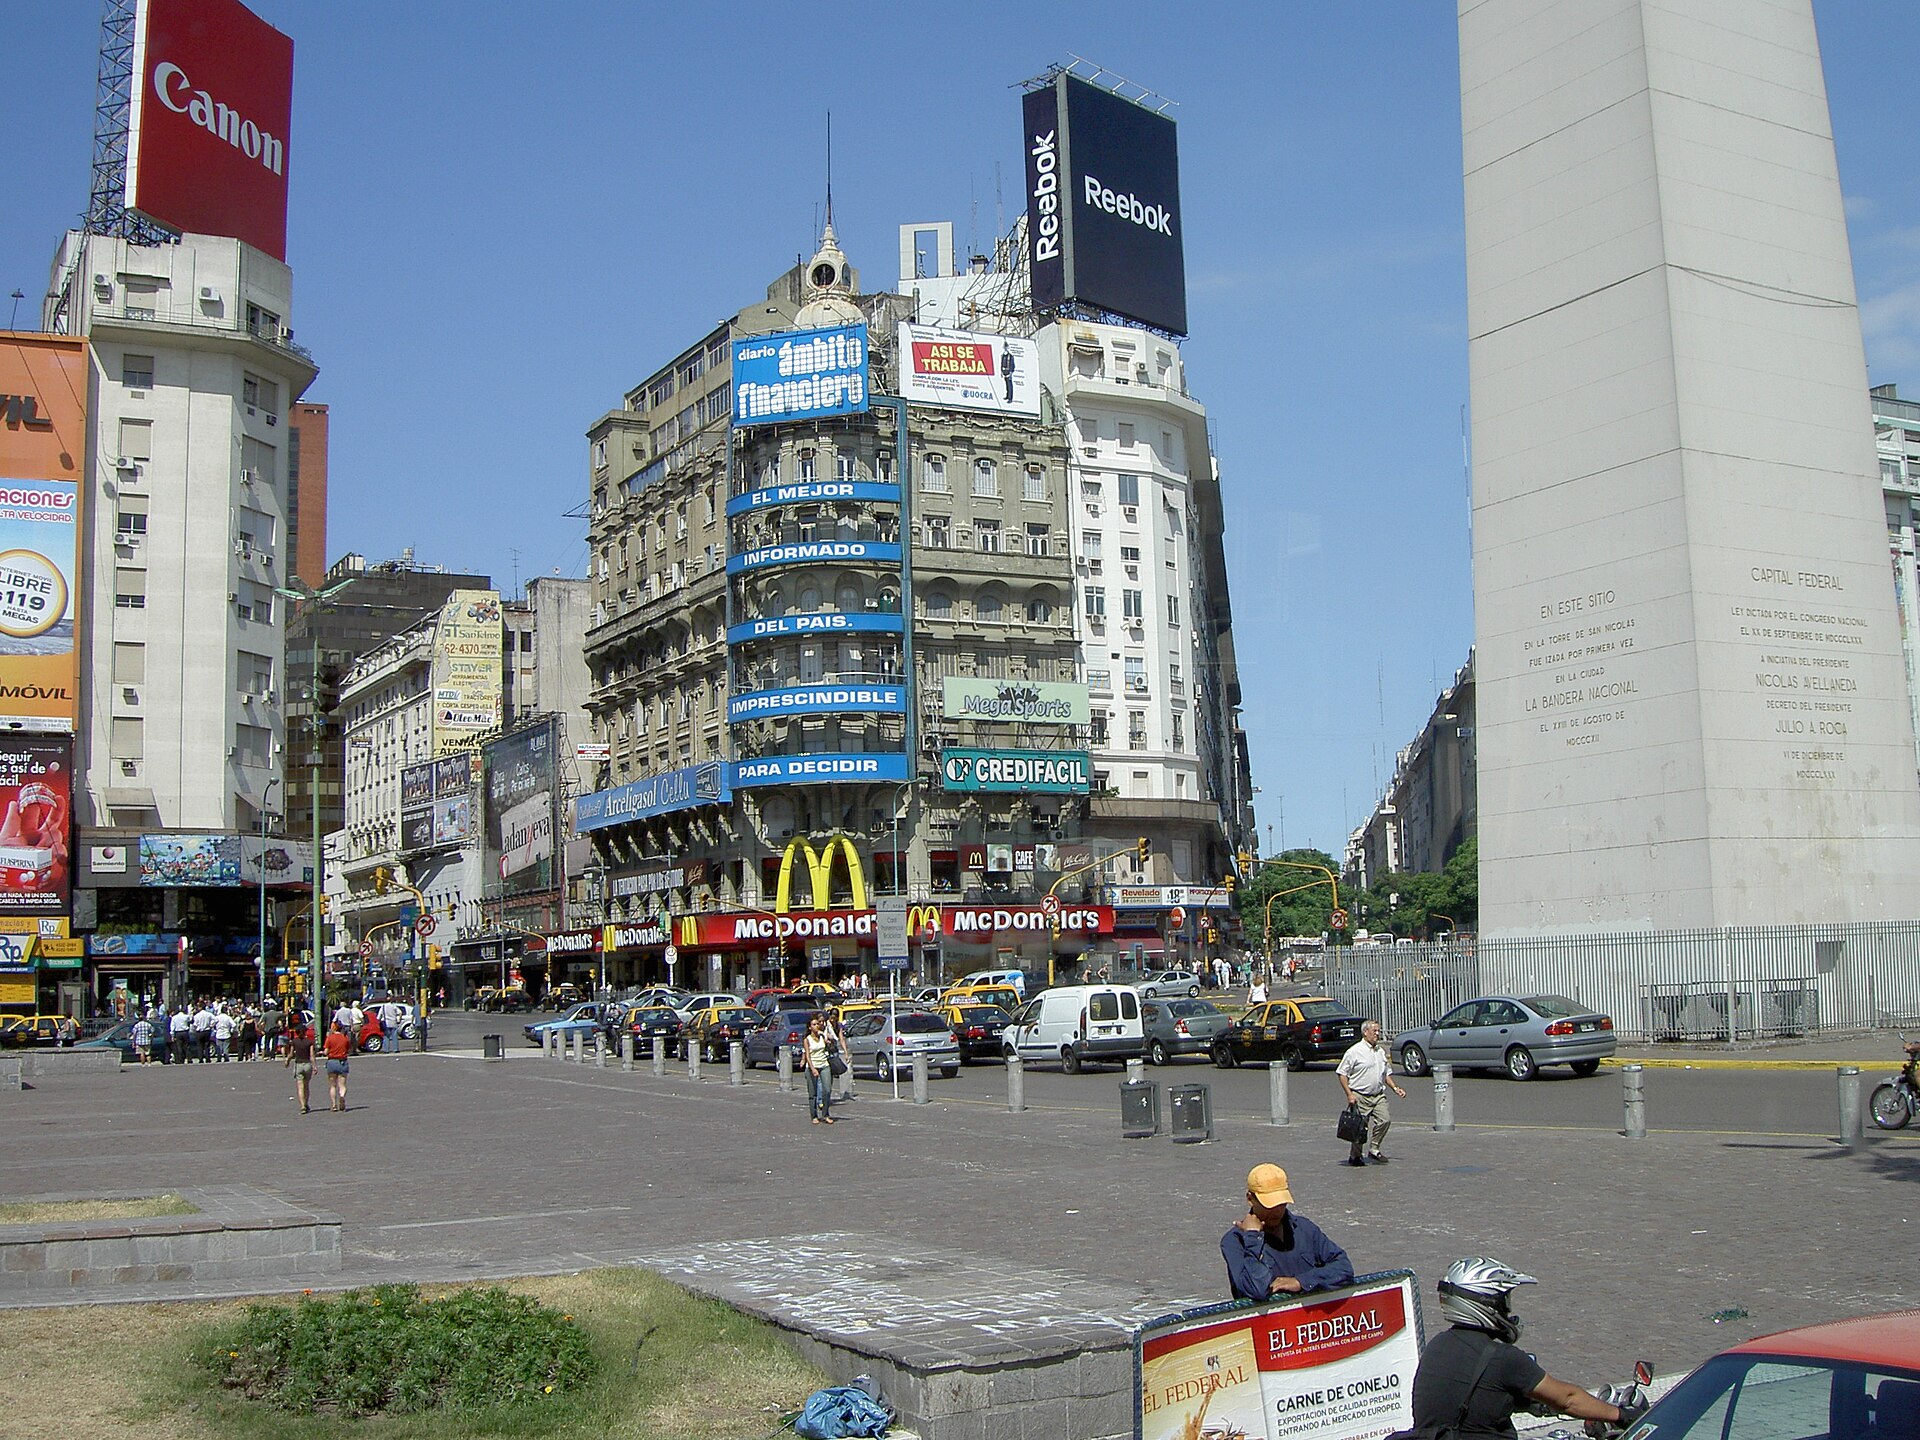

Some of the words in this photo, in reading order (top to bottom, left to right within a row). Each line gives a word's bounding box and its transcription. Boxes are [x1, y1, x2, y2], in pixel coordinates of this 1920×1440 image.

[154, 62, 283, 176] Canon
[1032, 129, 1059, 262] Reebok
[1084, 175, 1172, 236] Reebok
[738, 345, 775, 361] diario
[778, 335, 862, 377] ámbito
[931, 346, 953, 358] ASI
[956, 347, 974, 359] SE
[921, 358, 986, 373] TRABAJA
[738, 374, 863, 419] financiero
[969, 390, 994, 400] UOCRA
[752, 492, 771, 505] EL
[778, 484, 854, 500] MEJOR
[744, 543, 865, 566] INFORMADO
[1751, 567, 1793, 586] CAPITAL
[1798, 572, 1844, 591] FEDERAL
[1541, 605, 1553, 619] EN
[1558, 597, 1583, 615] ESTE
[1588, 590, 1616, 608] SITIO
[2, 609, 39, 624] MEGAS
[754, 620, 788, 635] DEL
[796, 615, 853, 630] PAIS.
[1731, 607, 1744, 616] LEY
[1746, 608, 1772, 618] DICTADA
[1774, 611, 1788, 620] POR
[1789, 612, 1798, 621] EL
[1800, 613, 1836, 624] CONGRESO
[1837, 616, 1868, 627] NACIONAL
[1524, 641, 1533, 650] EN
[1536, 639, 1545, 648] LA
[1549, 633, 1571, 645] TORRE
[1575, 630, 1584, 639] DE
[1588, 626, 1601, 636] SAN
[1605, 619, 1635, 632] NICOLAS
[1740, 627, 1749, 636] EL
[1763, 629, 1772, 637] DE
[1774, 629, 1813, 641] SEPTIEMBRE
[1815, 632, 1824, 641] DE
[1529, 658, 1542, 667] FUE
[1545, 652, 1565, 664] IZADA
[1568, 649, 1582, 659] POR
[1586, 642, 1615, 656] PRIMERA
[1620, 638, 1634, 648] VEZ
[1761, 655, 1765, 663] A
[1799, 657, 1811, 666] DEL
[1813, 658, 1850, 669] PRESIDENTE
[1556, 674, 1565, 684] EN
[1568, 672, 1577, 681] LA
[1580, 667, 1605, 679] CIUDAD
[1756, 673, 1799, 689] NICOLAS
[1804, 676, 1858, 692] AVELLANEDA
[732, 691, 896, 714] IMPRESCINDIBLE
[1525, 698, 1537, 712] LA
[1542, 689, 1584, 709] BANDERA
[1588, 680, 1639, 700] NACIONAL
[1766, 700, 1797, 710] DECRETO
[1799, 701, 1812, 711] DEL
[1815, 702, 1852, 713] PRESIDENTE
[1540, 724, 1549, 732] EL
[1570, 718, 1579, 727] DE
[1583, 713, 1611, 725] AGOSTO
[1615, 711, 1625, 720] DE
[1775, 720, 1804, 734] JULIO
[1820, 721, 1848, 735] ROCA
[442, 738, 475, 747] VENTA
[1791, 751, 1800, 760] DE
[1801, 751, 1835, 761] DICIEMBRE
[1836, 752, 1844, 761] DE
[11, 763, 28, 774] así
[31, 761, 46, 774] de
[738, 764, 781, 779] PARA
[788, 759, 878, 775] DECIDIR
[975, 758, 1088, 784] CREDIFACIL
[604, 779, 657, 818] Arceligasol
[1121, 889, 1160, 897] Revelado
[735, 913, 879, 939] McDonald'
[547, 933, 593, 953] McDonald's
[1267, 1328, 1293, 1352] EL
[1296, 1309, 1383, 1346] FEDERAL
[1277, 1350, 1295, 1358] REVISTA
[1320, 1340, 1341, 1349] GENERAL
[1367, 1331, 1384, 1339] CAMPO
[1143, 1393, 1162, 1415] EL
[1165, 1365, 1250, 1406] FEDERAL
[1276, 1391, 1324, 1413] CARNE
[1327, 1386, 1344, 1401] DE
[1347, 1374, 1399, 1397] CONEJO
[1277, 1407, 1327, 1427] EXPORTACION
[1328, 1405, 1338, 1415] DE
[1338, 1399, 1369, 1413] CALIDAD
[1369, 1391, 1401, 1406] PREMIUM
[1278, 1420, 1320, 1437] ENTRANDO
[1320, 1418, 1331, 1427] AL
[1331, 1409, 1367, 1425] MERCADO
[1367, 1403, 1402, 1416] EUROPEO.
[1379, 1427, 1396, 1436] CASA
